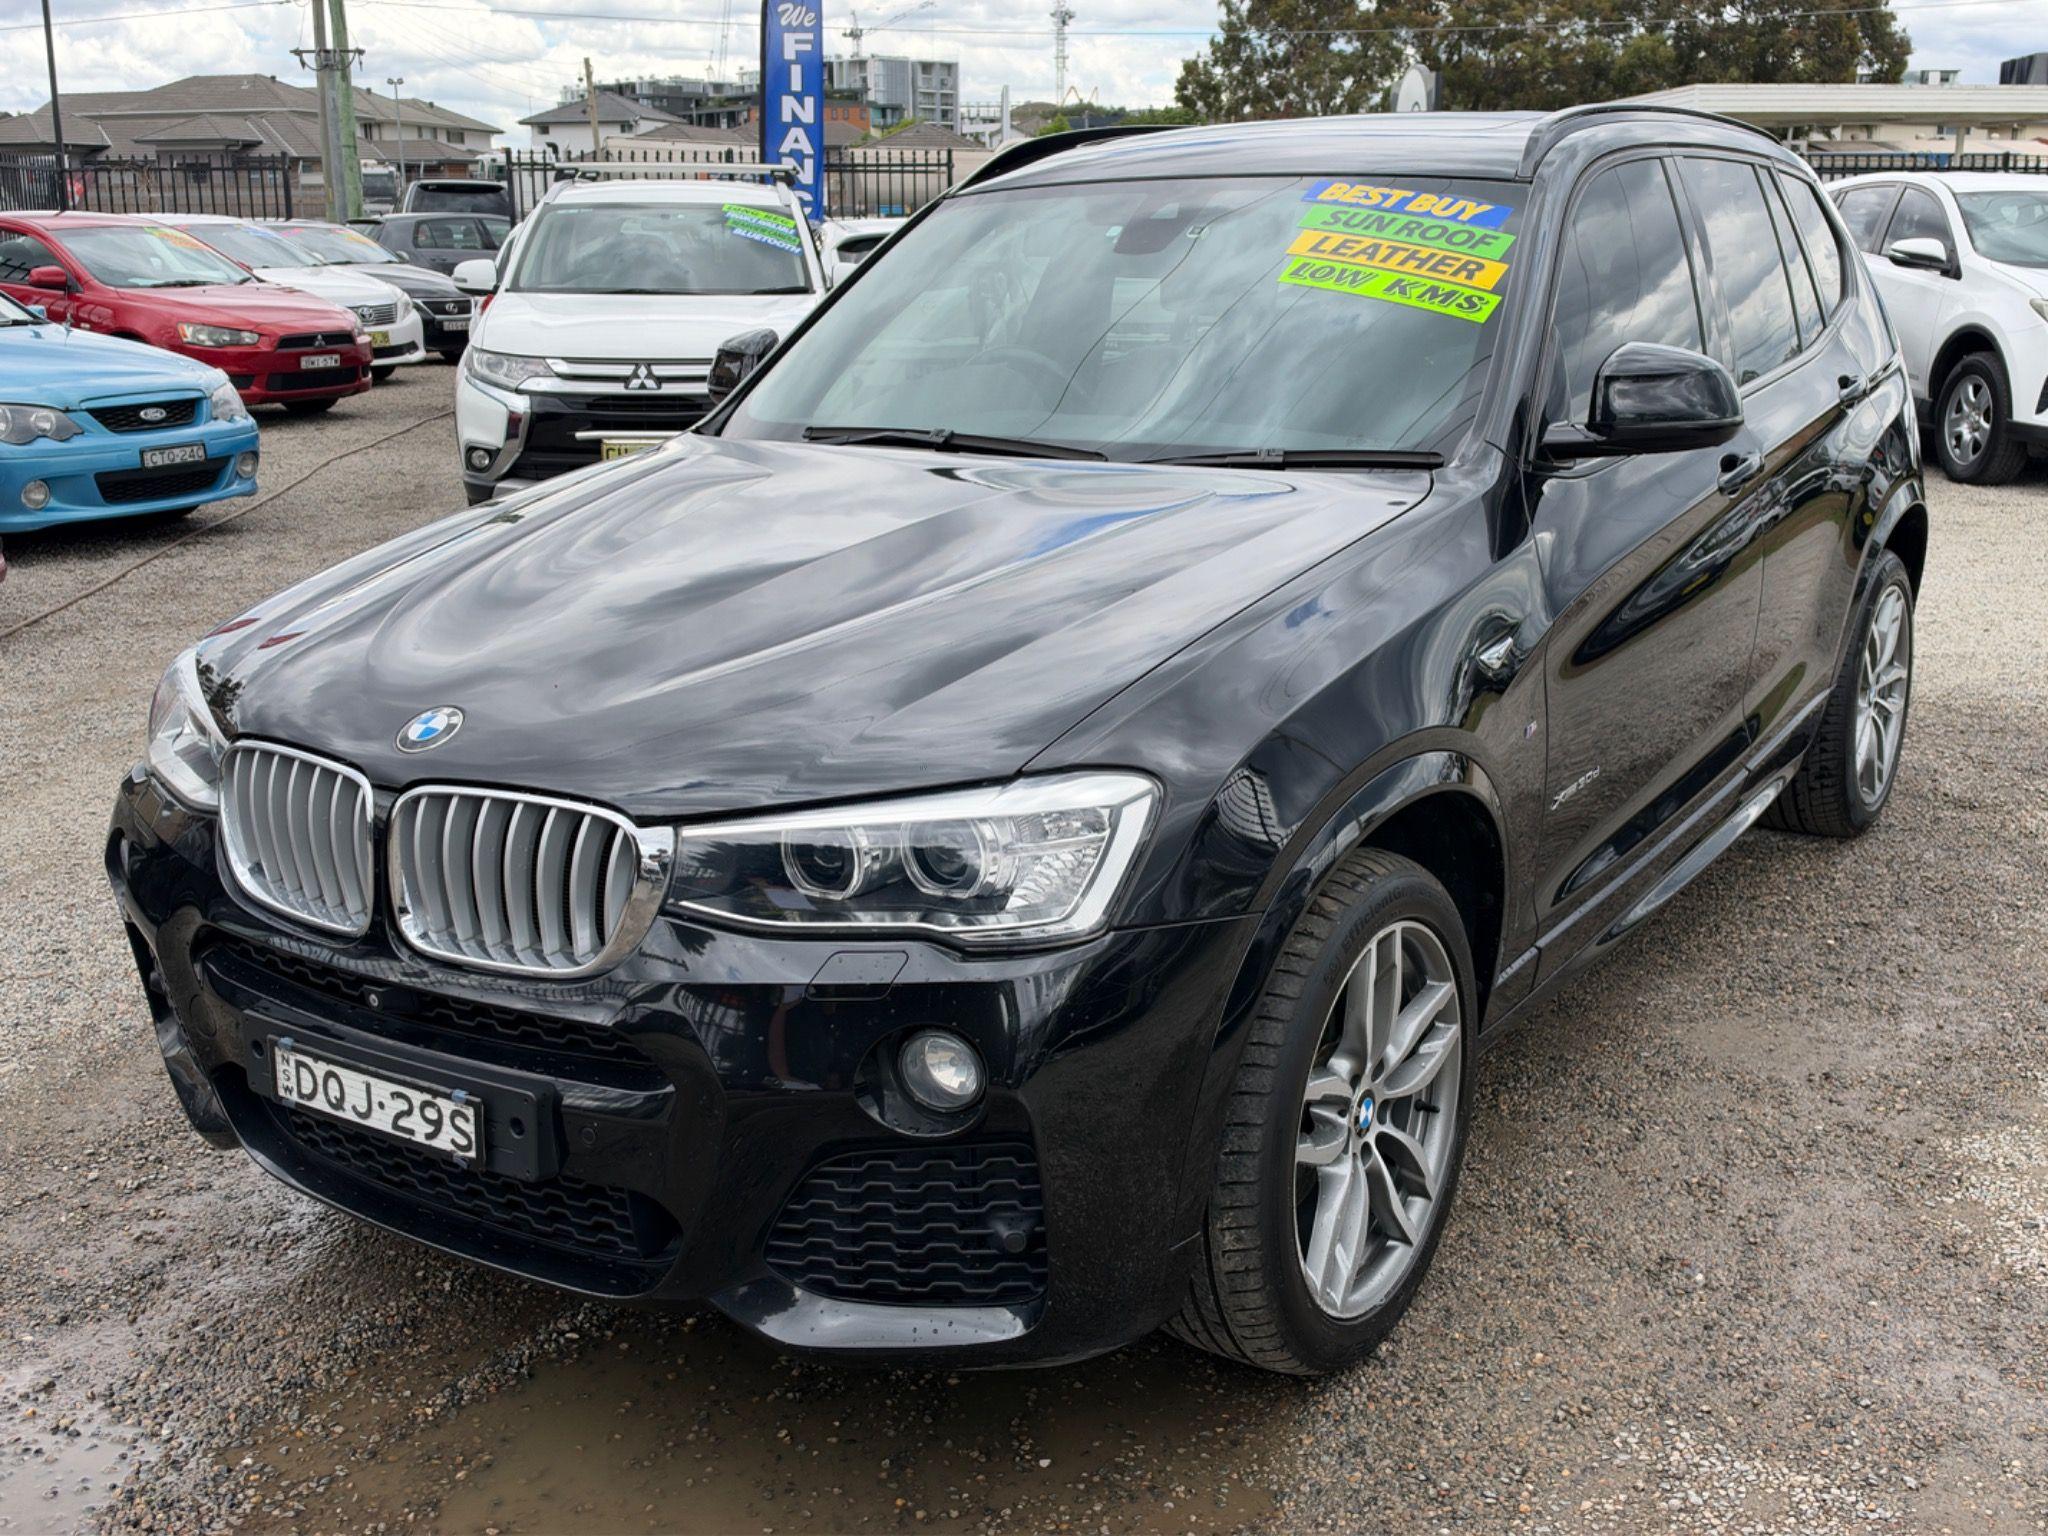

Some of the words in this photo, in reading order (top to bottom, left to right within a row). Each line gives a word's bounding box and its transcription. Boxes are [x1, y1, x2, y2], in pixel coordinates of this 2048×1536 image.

[778, 2, 817, 26] We
[1317, 181, 1415, 209] BEST
[1404, 193, 1494, 222] BUY
[733, 228, 803, 254] BLUETOOTH
[1321, 209, 1402, 234] SUN
[1399, 221, 1500, 250] ROOF
[1308, 235, 1485, 281] LEATHER
[1288, 261, 1378, 288] LOW
[1384, 278, 1490, 314] KMS
